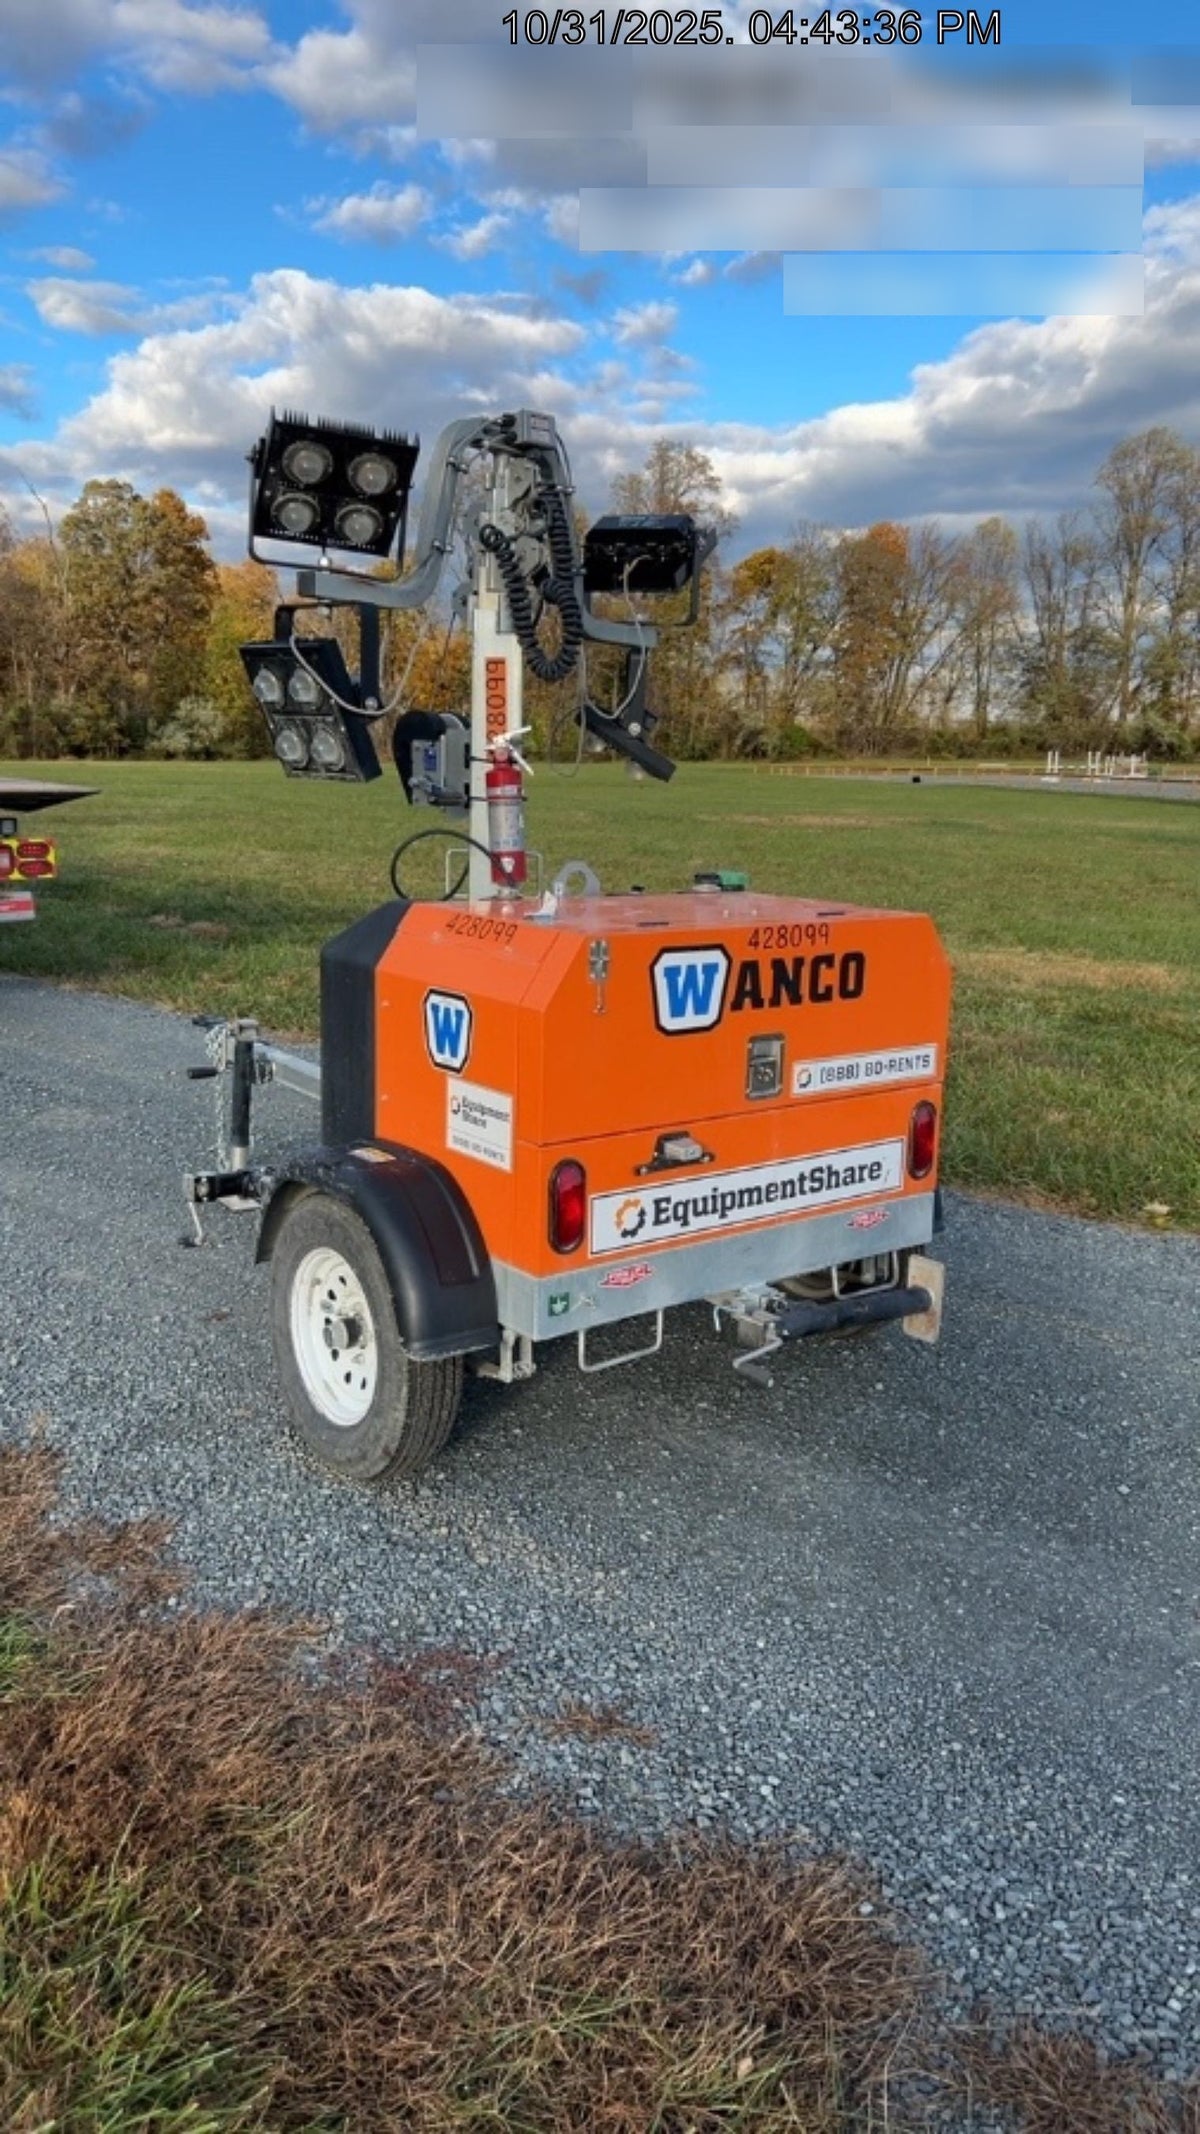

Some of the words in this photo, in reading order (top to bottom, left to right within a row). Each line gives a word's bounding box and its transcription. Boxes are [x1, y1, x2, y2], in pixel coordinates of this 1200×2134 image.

[486, 658, 506, 744] 28099
[445, 913, 518, 945] 428099
[748, 923, 829, 949] 428099
[660, 950, 866, 1020] WANCO
[430, 1002, 465, 1059] W
[652, 1160, 883, 1227] EquipmentShare
